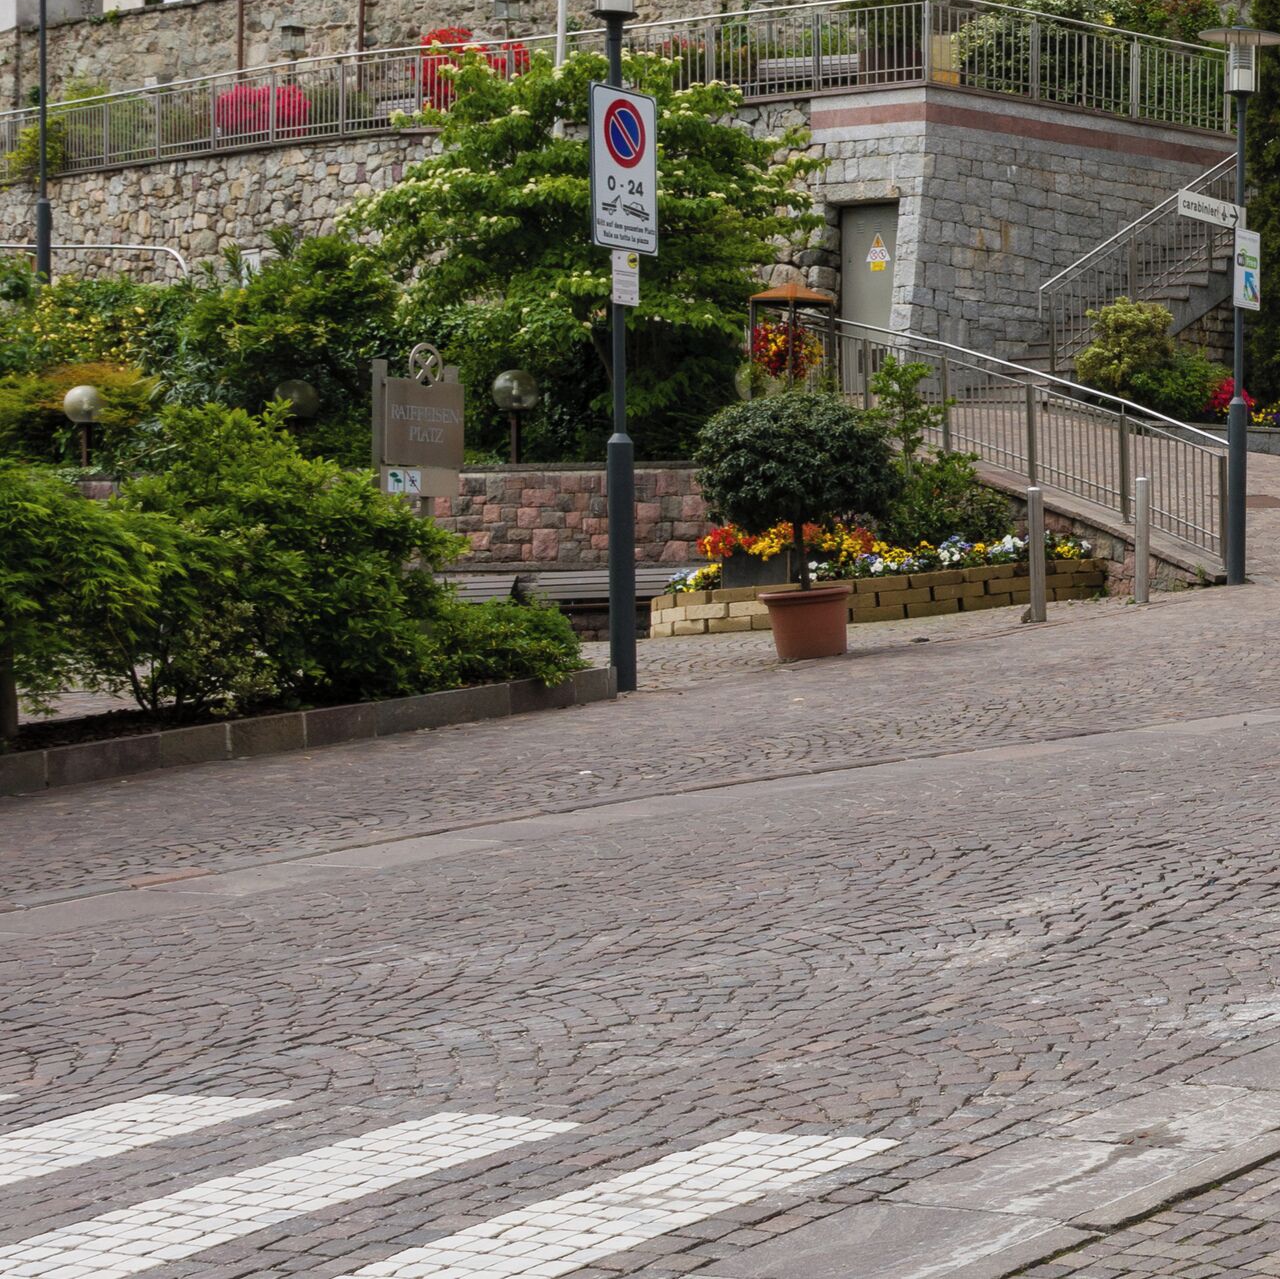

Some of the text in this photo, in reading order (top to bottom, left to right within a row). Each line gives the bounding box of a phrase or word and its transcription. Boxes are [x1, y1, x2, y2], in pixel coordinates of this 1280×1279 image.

[607, 175, 616, 191] 0
[627, 179, 644, 197] 24
[1182, 199, 1219, 218] carabinieri
[408, 426, 444, 443] PLATZ
